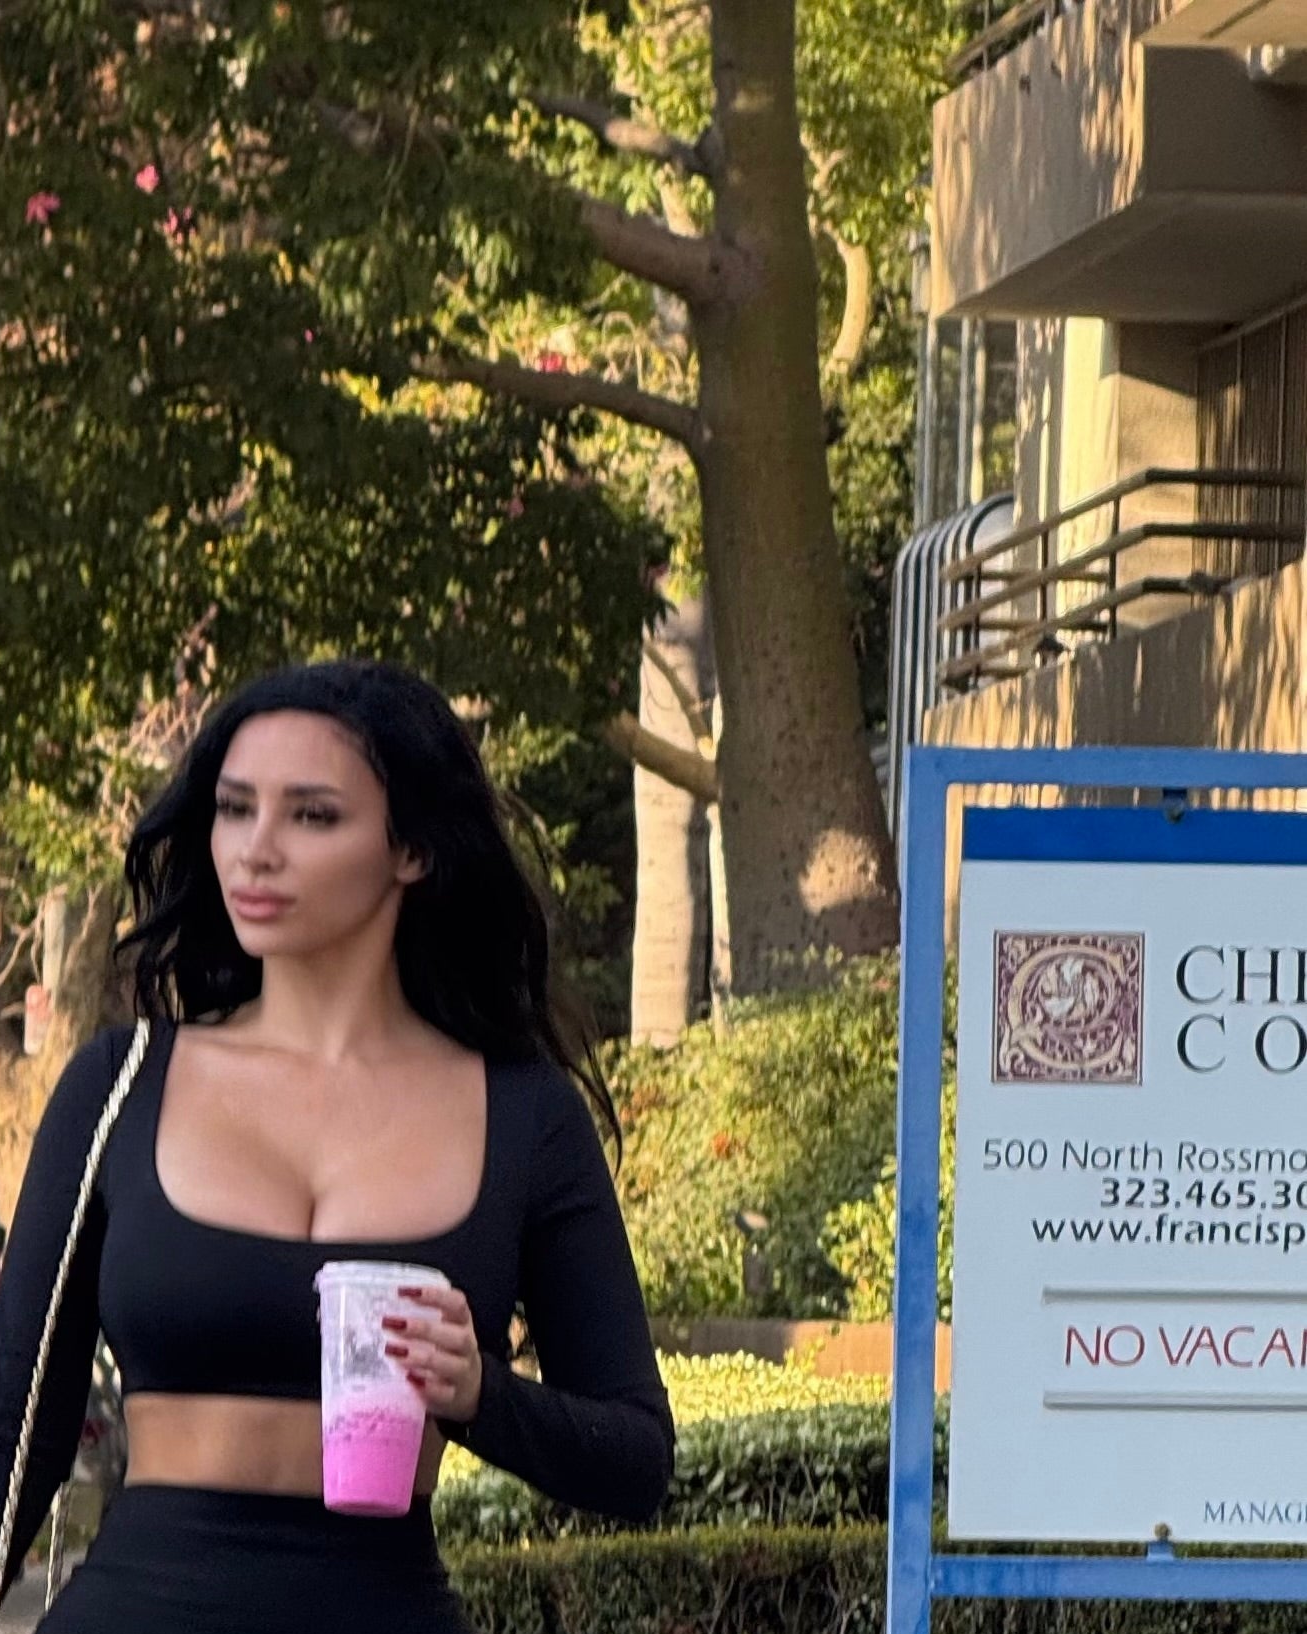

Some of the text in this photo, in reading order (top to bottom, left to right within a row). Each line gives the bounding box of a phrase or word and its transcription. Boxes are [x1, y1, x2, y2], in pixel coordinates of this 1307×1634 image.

[983, 1138, 1048, 1171] 500
[1062, 1140, 1163, 1172] North
[1031, 1213, 1306, 1254] www.francisp
[1065, 1324, 1307, 1369] NO VACA
[1203, 1500, 1307, 1524] MANAG
